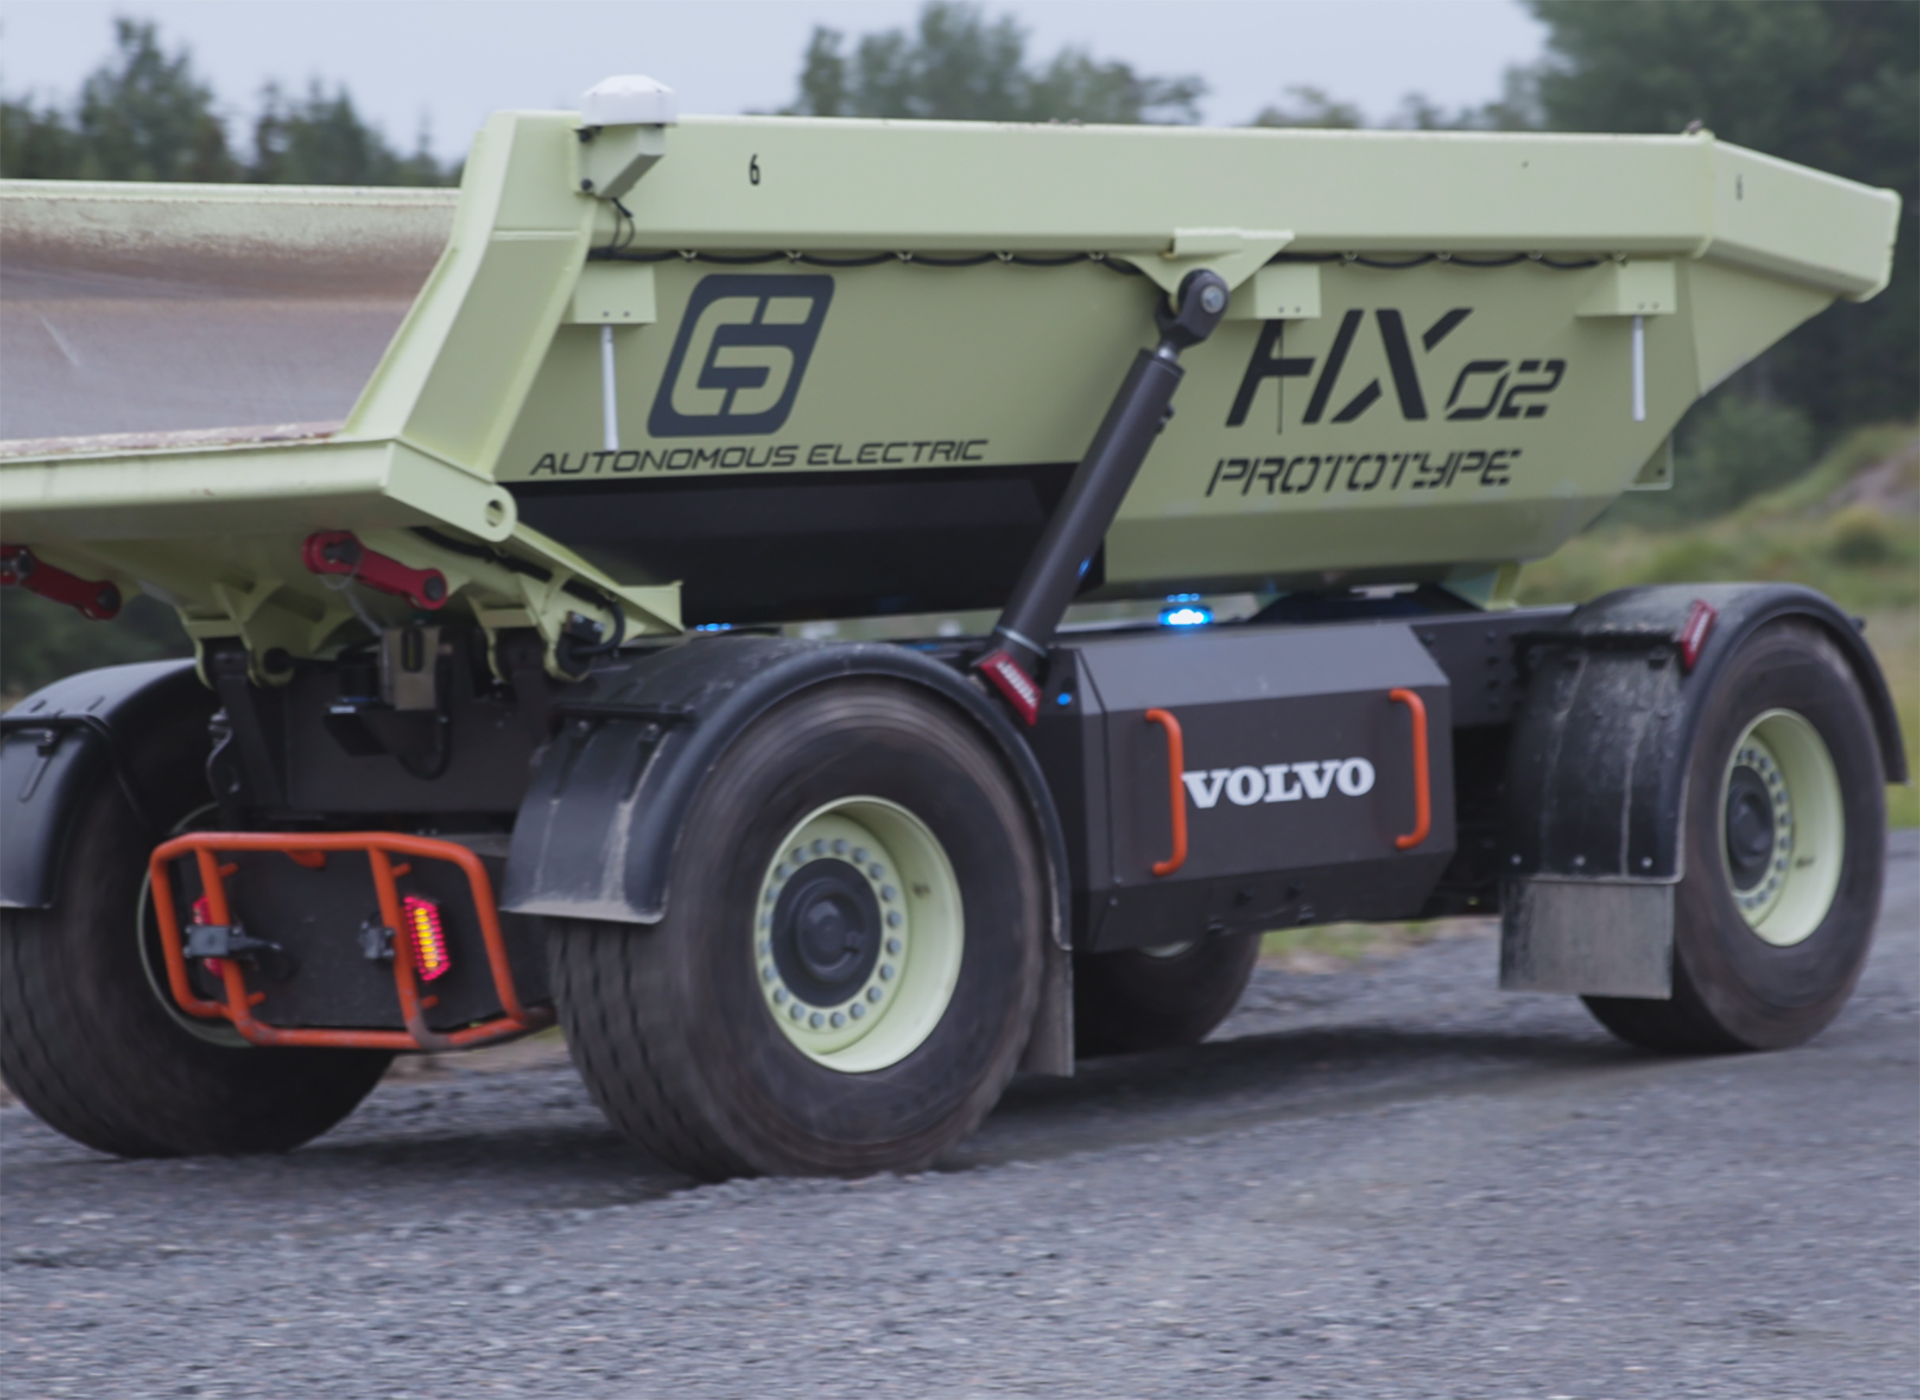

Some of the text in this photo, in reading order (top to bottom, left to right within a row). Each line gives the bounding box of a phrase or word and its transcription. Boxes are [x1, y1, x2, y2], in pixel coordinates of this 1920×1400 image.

[749, 153, 761, 186] 6
[529, 439, 989, 477] AUTONOMOUS ELECTRIC
[1205, 448, 1523, 498] PROTOTYPE
[1181, 757, 1376, 809] VOLVO
